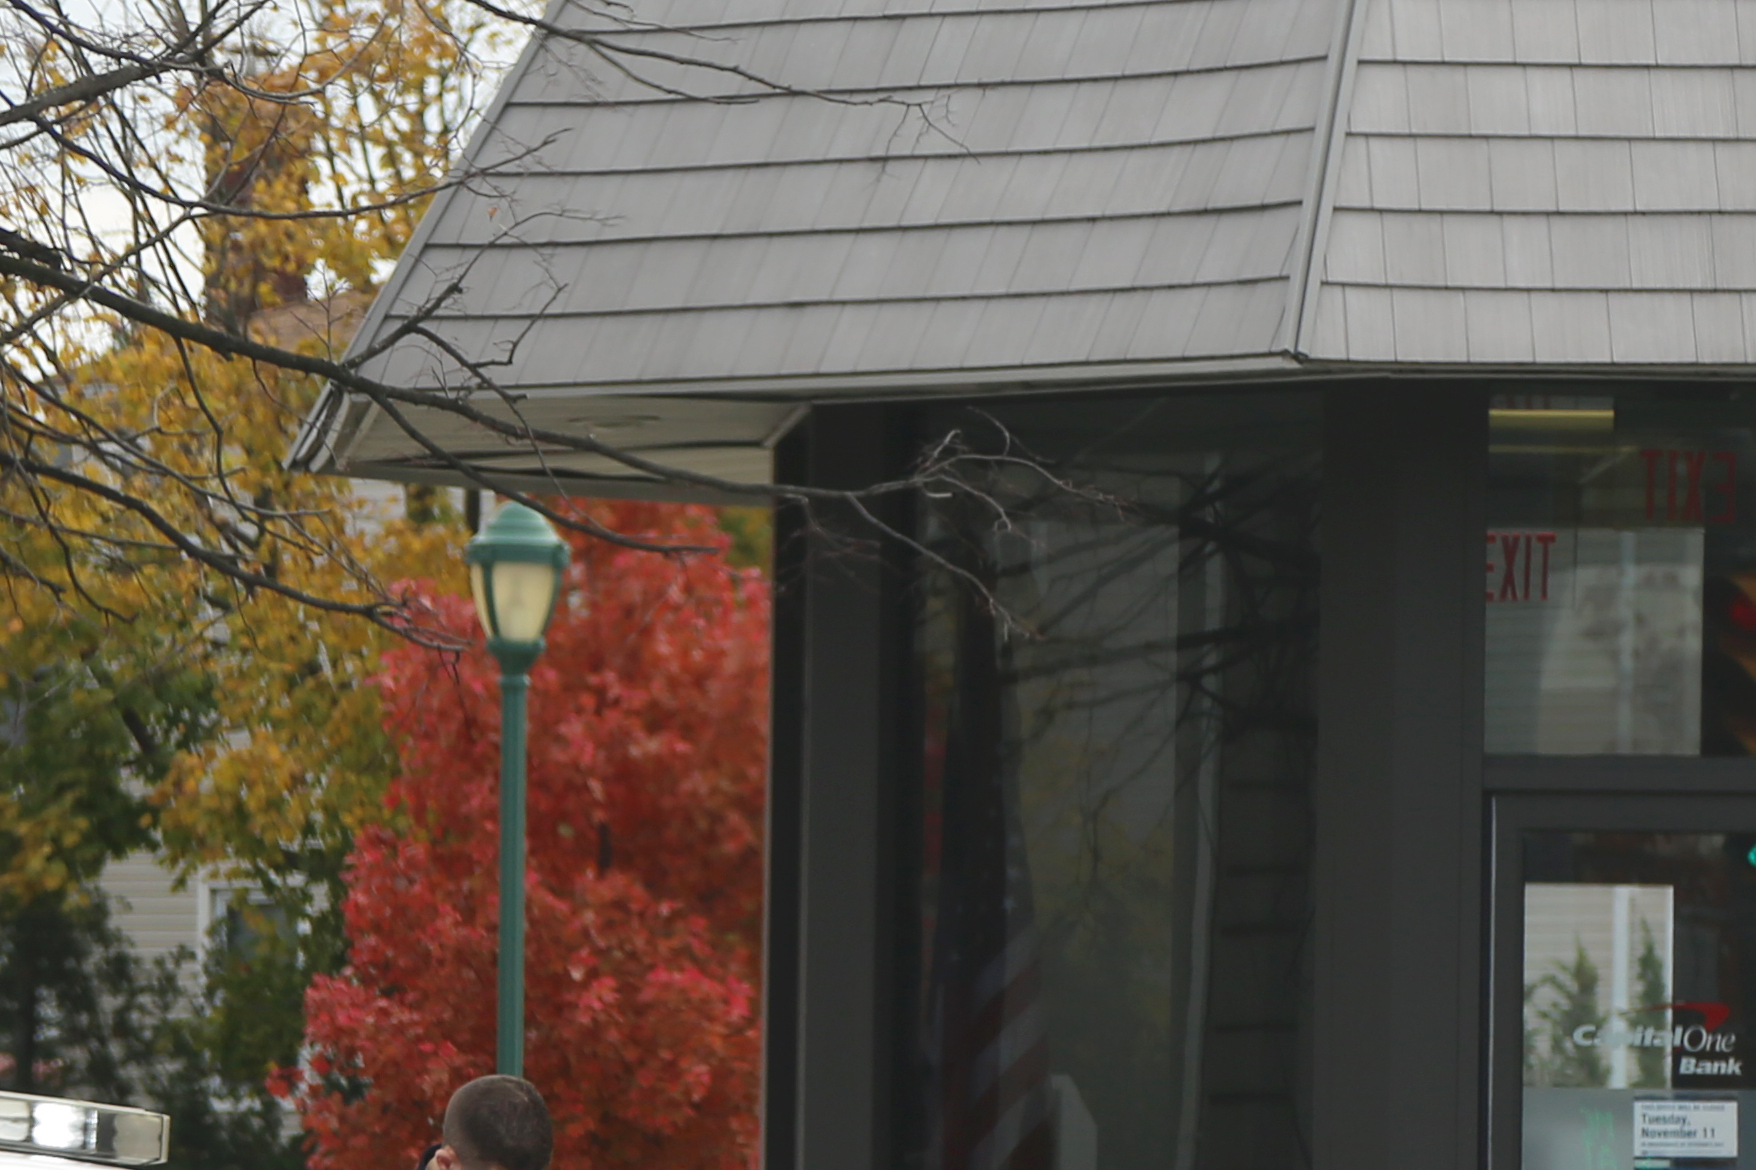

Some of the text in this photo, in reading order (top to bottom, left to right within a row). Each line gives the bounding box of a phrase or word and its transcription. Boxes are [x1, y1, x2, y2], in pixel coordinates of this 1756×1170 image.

[1679, 1056, 1743, 1076] Bank
[1641, 1113, 1691, 1126] Tuesday,
[1641, 1127, 1716, 1139] November 11
